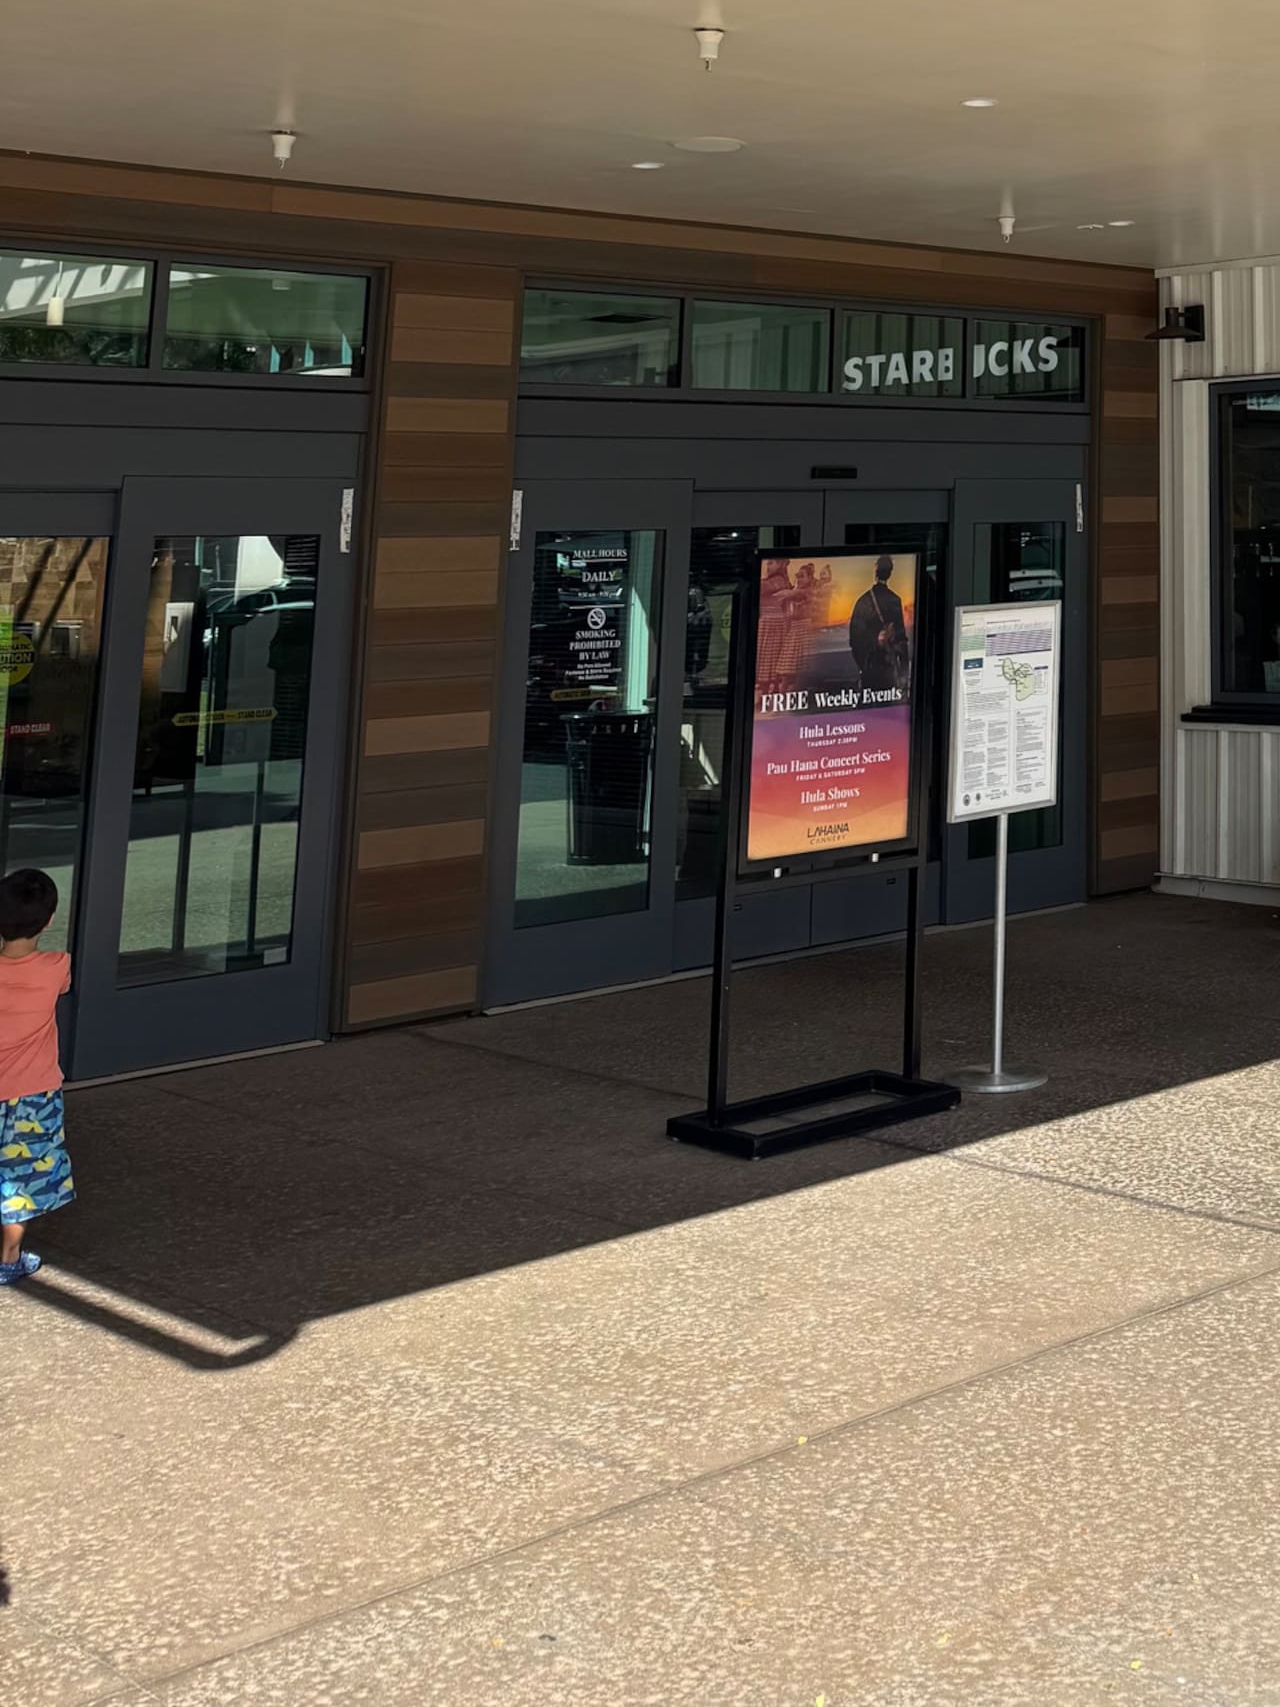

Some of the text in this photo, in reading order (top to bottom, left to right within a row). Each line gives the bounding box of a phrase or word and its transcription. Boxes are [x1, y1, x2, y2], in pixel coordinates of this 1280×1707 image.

[572, 549, 628, 559] MALL HOURS
[581, 571, 616, 583] DAILY
[575, 629, 616, 640] SMOKING
[569, 640, 622, 651] PROHIBITED
[579, 650, 610, 661] BY LAW
[760, 686, 903, 713] FREE Weekly Events
[799, 722, 866, 740] Hula Lessons
[807, 738, 837, 748] THURSDAY
[767, 749, 891, 775] Pau Hana Concert Series
[796, 772, 818, 781] FRIDAY
[823, 769, 852, 779] SATURDAY
[801, 787, 860, 804] Hula Shows
[813, 804, 835, 812] SUNDAY
[807, 823, 850, 839] LAHAINA
